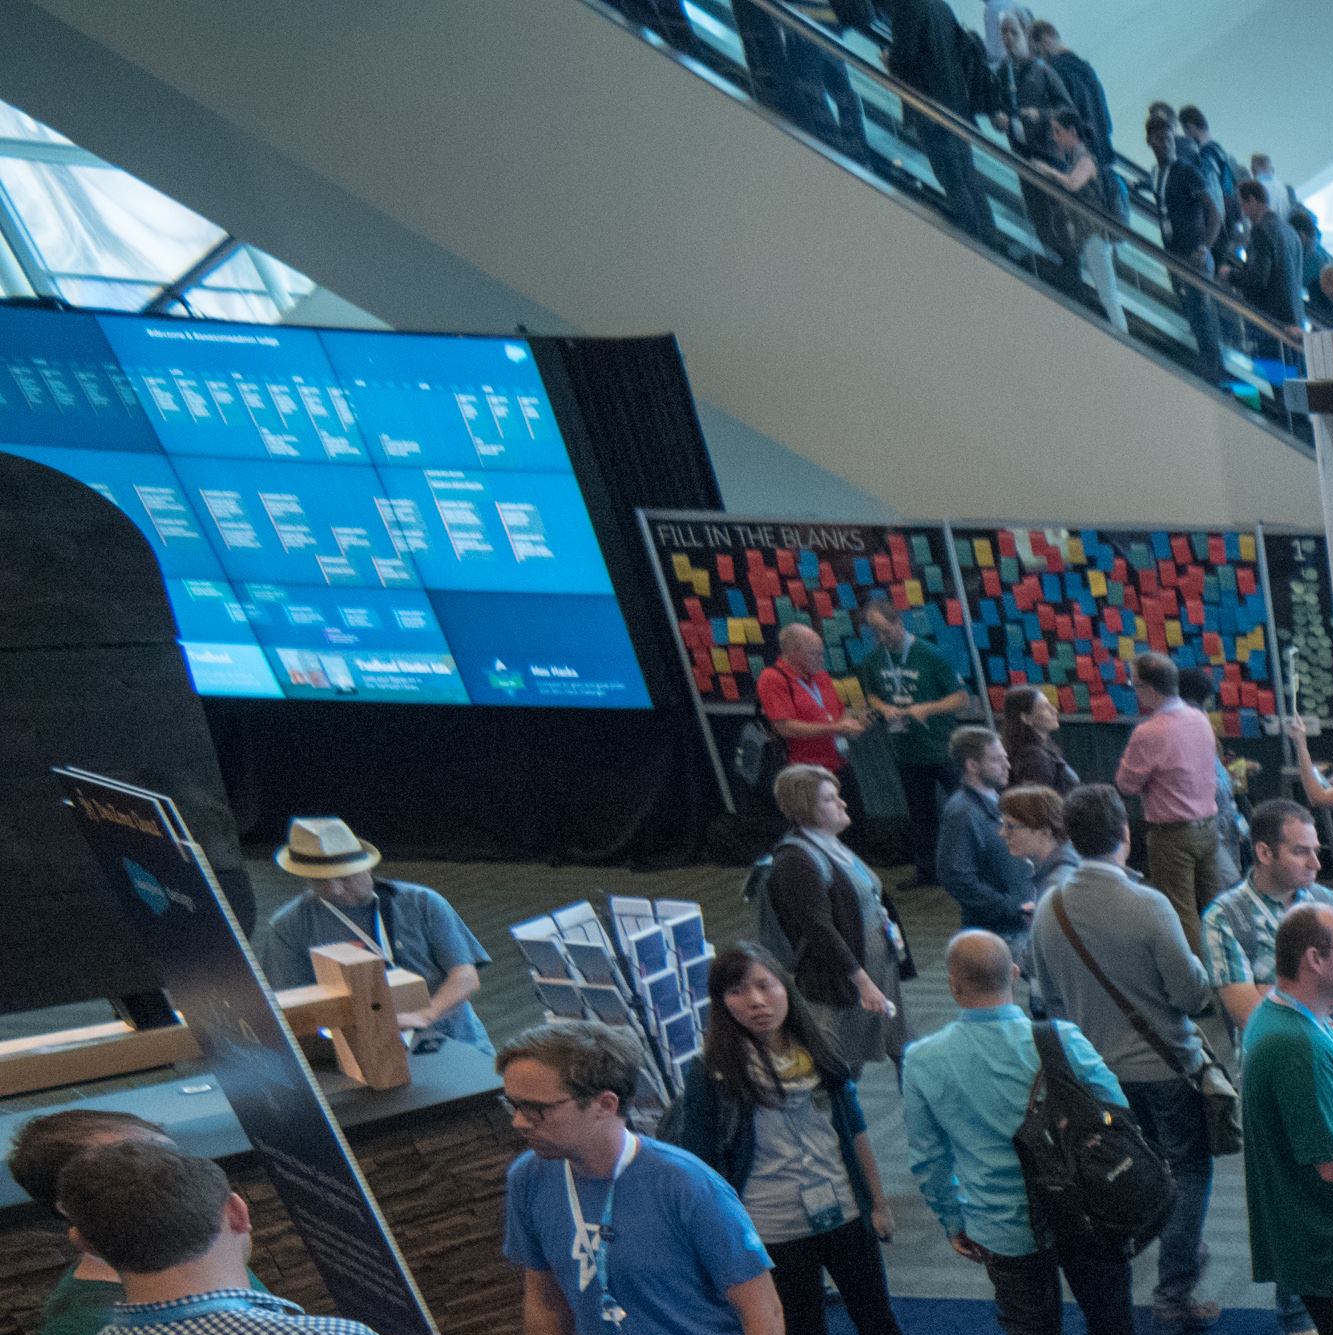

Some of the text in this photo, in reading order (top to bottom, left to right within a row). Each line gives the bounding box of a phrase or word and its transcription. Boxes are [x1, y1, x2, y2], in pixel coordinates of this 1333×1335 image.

[657, 524, 865, 552] FILL IN THE BLANKS
